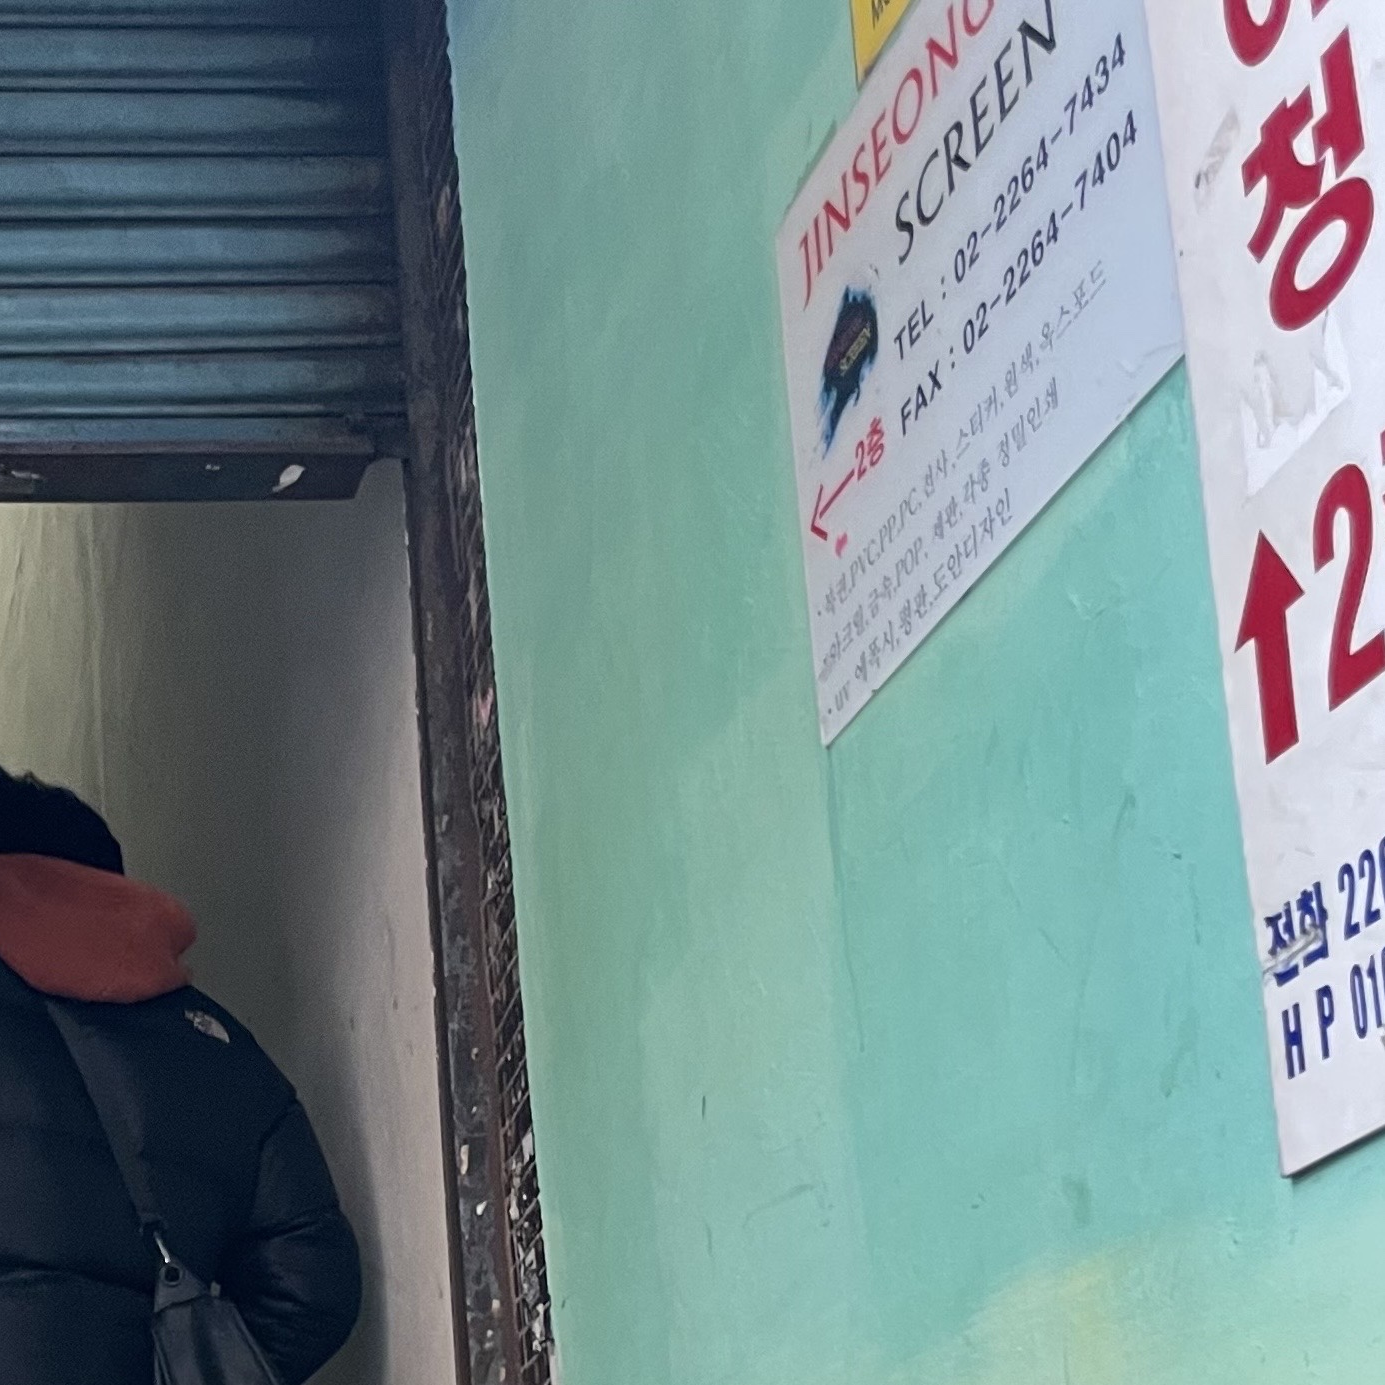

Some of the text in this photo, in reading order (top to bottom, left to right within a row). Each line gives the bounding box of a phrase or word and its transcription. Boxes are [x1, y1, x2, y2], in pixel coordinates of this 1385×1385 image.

[894, 300, 933, 360] TEL
[954, 34, 1125, 283] 02-2264-7434
[896, 0, 1056, 264] SCREEN
[901, 361, 941, 435] FAX
[963, 111, 1136, 354] 02-2264-7404
[856, 418, 884, 480] 2층
[1313, 432, 1385, 712] 2
[1338, 837, 1385, 940] 22
[1350, 946, 1385, 1039] 01
